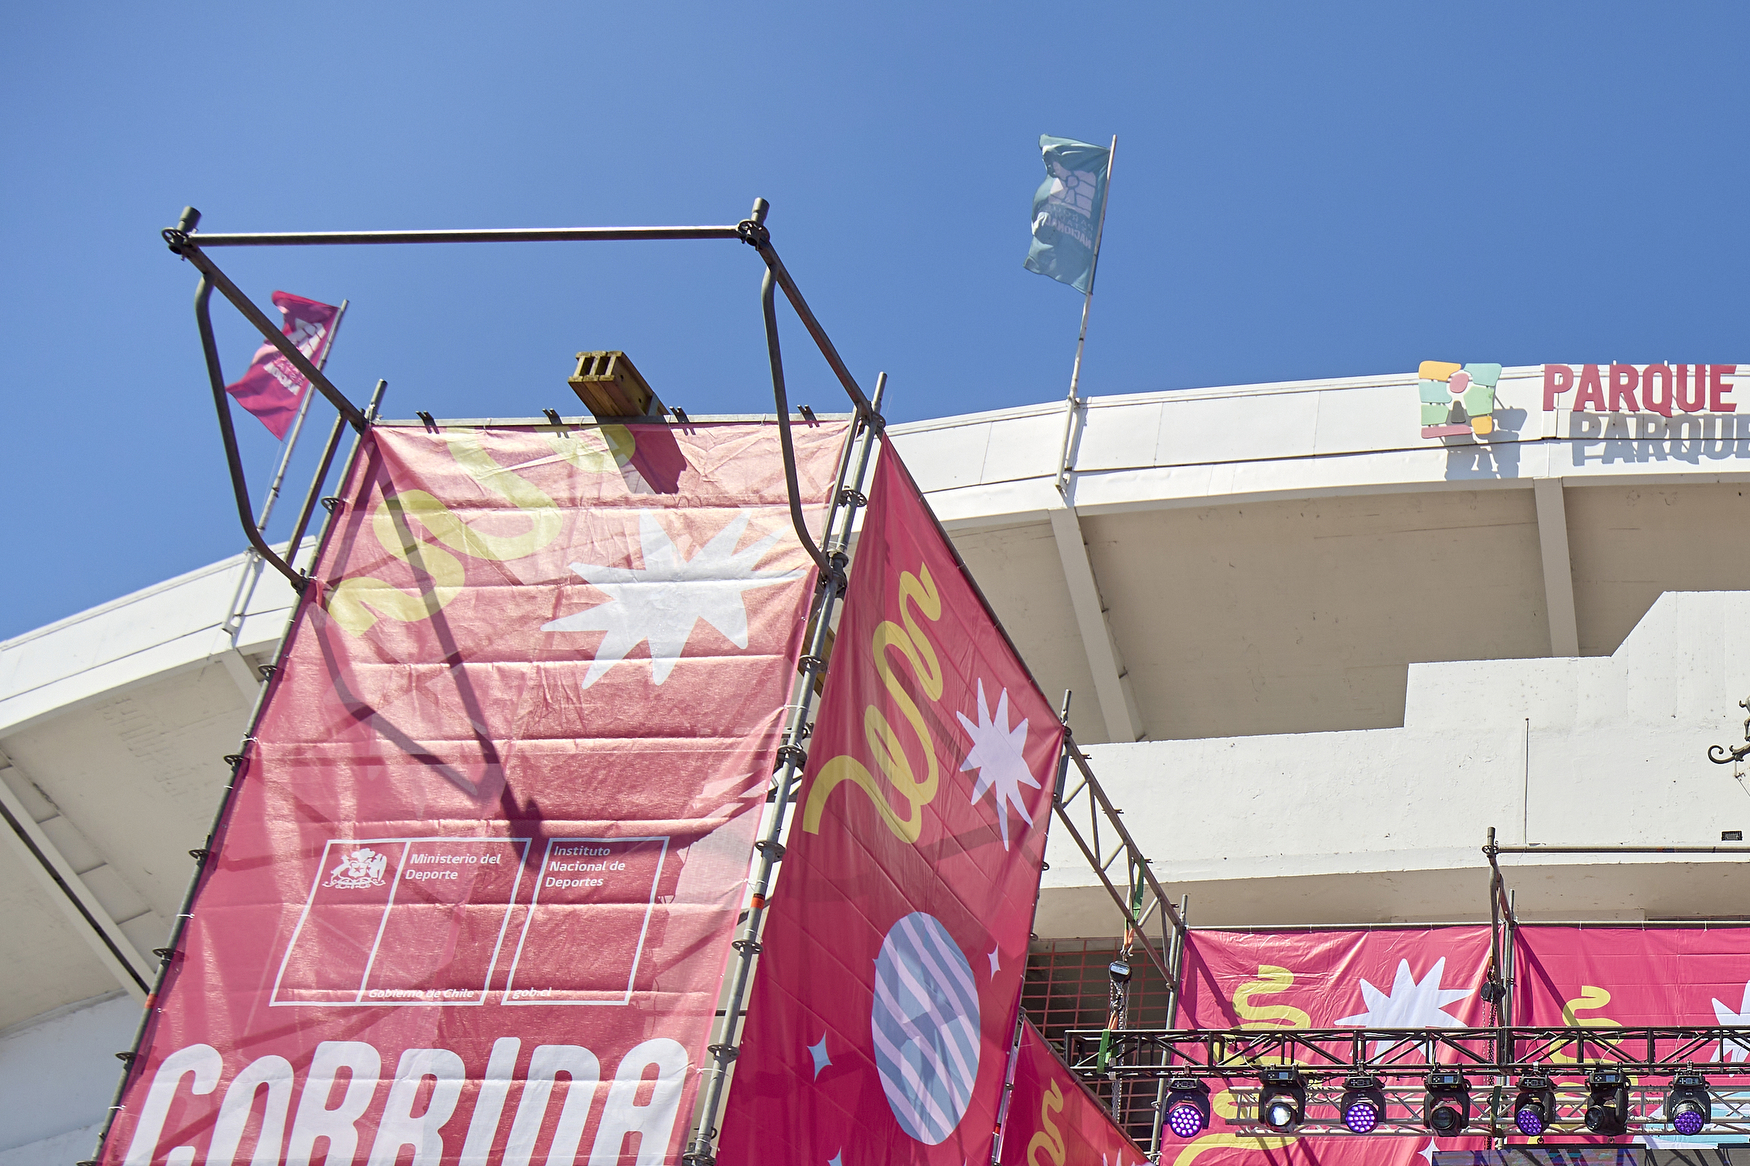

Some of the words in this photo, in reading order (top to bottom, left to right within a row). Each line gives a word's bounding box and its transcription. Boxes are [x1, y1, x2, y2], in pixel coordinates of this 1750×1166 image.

[1543, 364, 1737, 417] PARQUE
[553, 846, 611, 857] Instituto
[410, 853, 477, 866] Ministerio
[480, 853, 501, 865] del
[549, 860, 606, 873] Nacional
[610, 860, 626, 872] de
[405, 869, 459, 882] Deporte
[545, 876, 604, 889] Deportes
[368, 987, 425, 998] Gobierno
[427, 988, 442, 998] de
[444, 987, 475, 998] Chile
[512, 987, 552, 999] gob.cl
